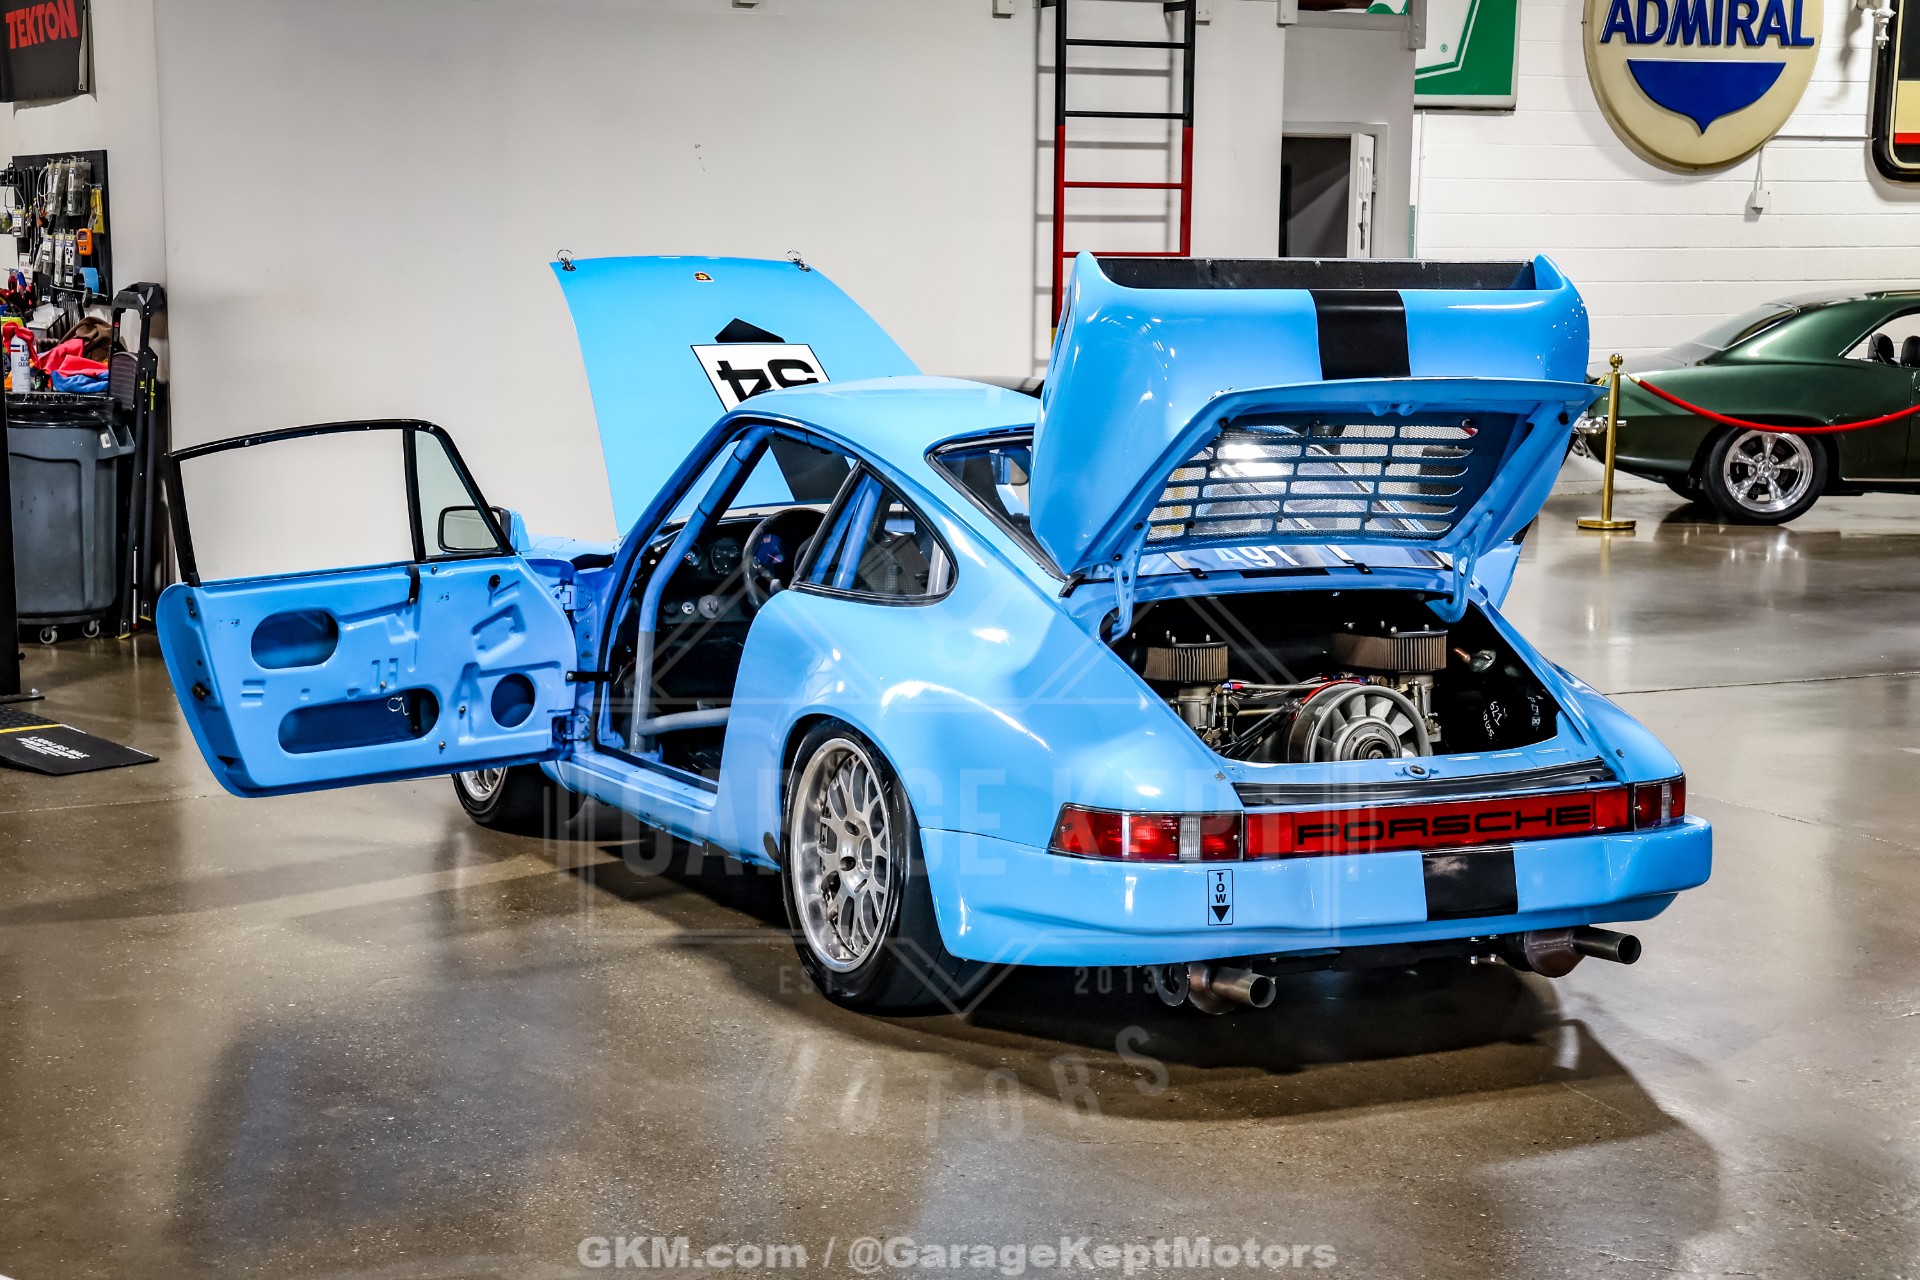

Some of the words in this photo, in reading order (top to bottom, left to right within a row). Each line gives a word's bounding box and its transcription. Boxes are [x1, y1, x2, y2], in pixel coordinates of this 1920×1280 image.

[5, 0, 78, 49] TEKTON
[1600, 0, 1815, 46] ADMIRAL
[1297, 804, 1592, 846] PORSCHE
[1215, 872, 1227, 904] TOW
